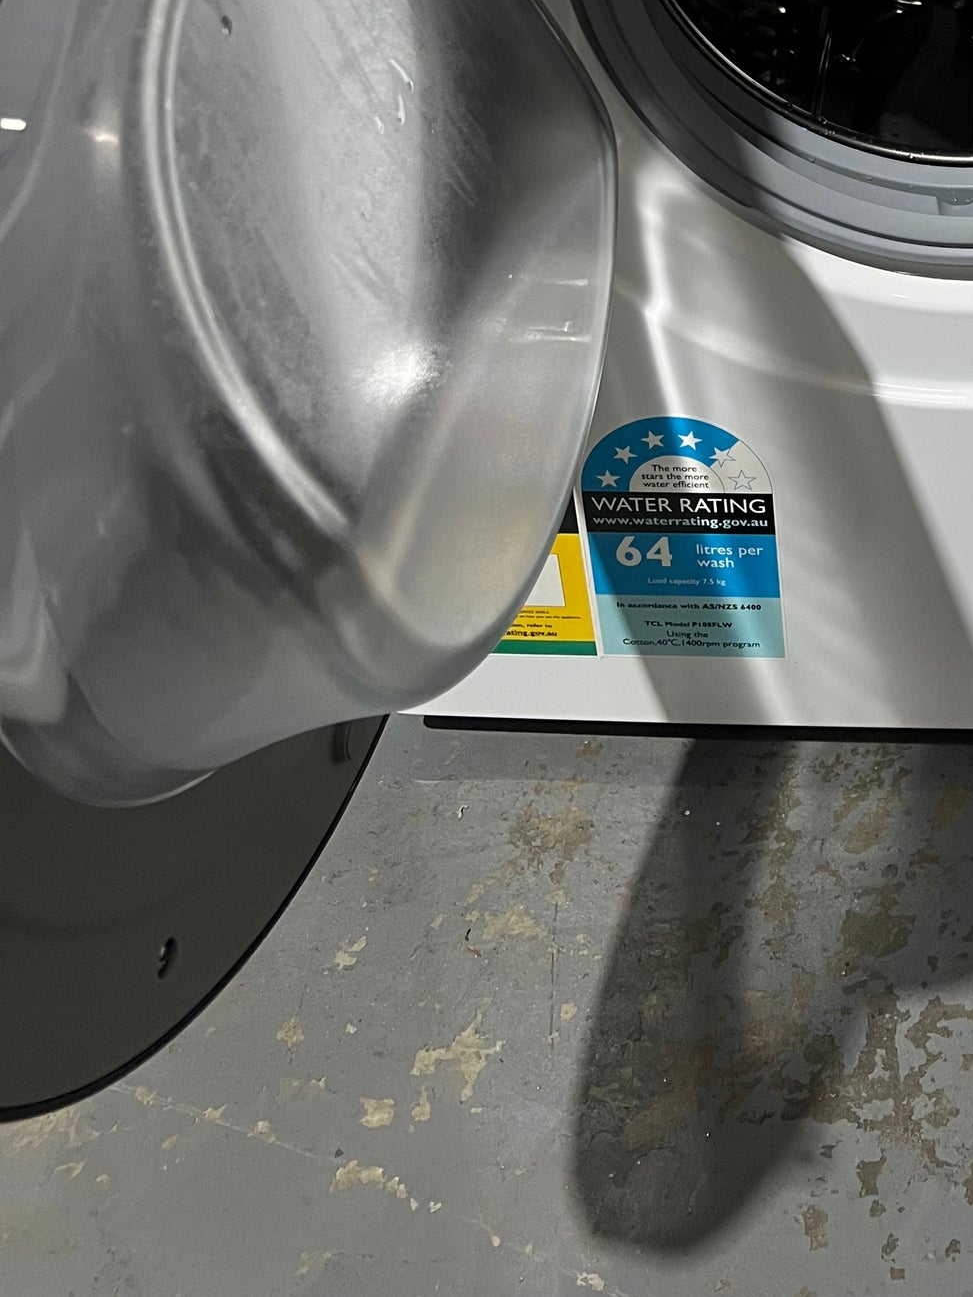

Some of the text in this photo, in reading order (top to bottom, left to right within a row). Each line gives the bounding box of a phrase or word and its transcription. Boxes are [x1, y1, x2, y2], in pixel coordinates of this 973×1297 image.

[651, 464, 670, 472] The
[666, 472, 681, 480] the
[642, 480, 710, 489] water efficient
[591, 496, 767, 514] WATER RATING
[592, 515, 769, 530] www.waterrating.gov.au
[615, 535, 673, 568] 64
[696, 543, 764, 559] litres per
[696, 556, 735, 569] wash
[616, 601, 626, 609] In
[627, 602, 678, 610] accordance
[702, 603, 738, 611] AS/NZS
[740, 603, 762, 611] 6400
[664, 620, 690, 628] Model
[666, 630, 709, 640] Using the
[722, 640, 760, 650] program
